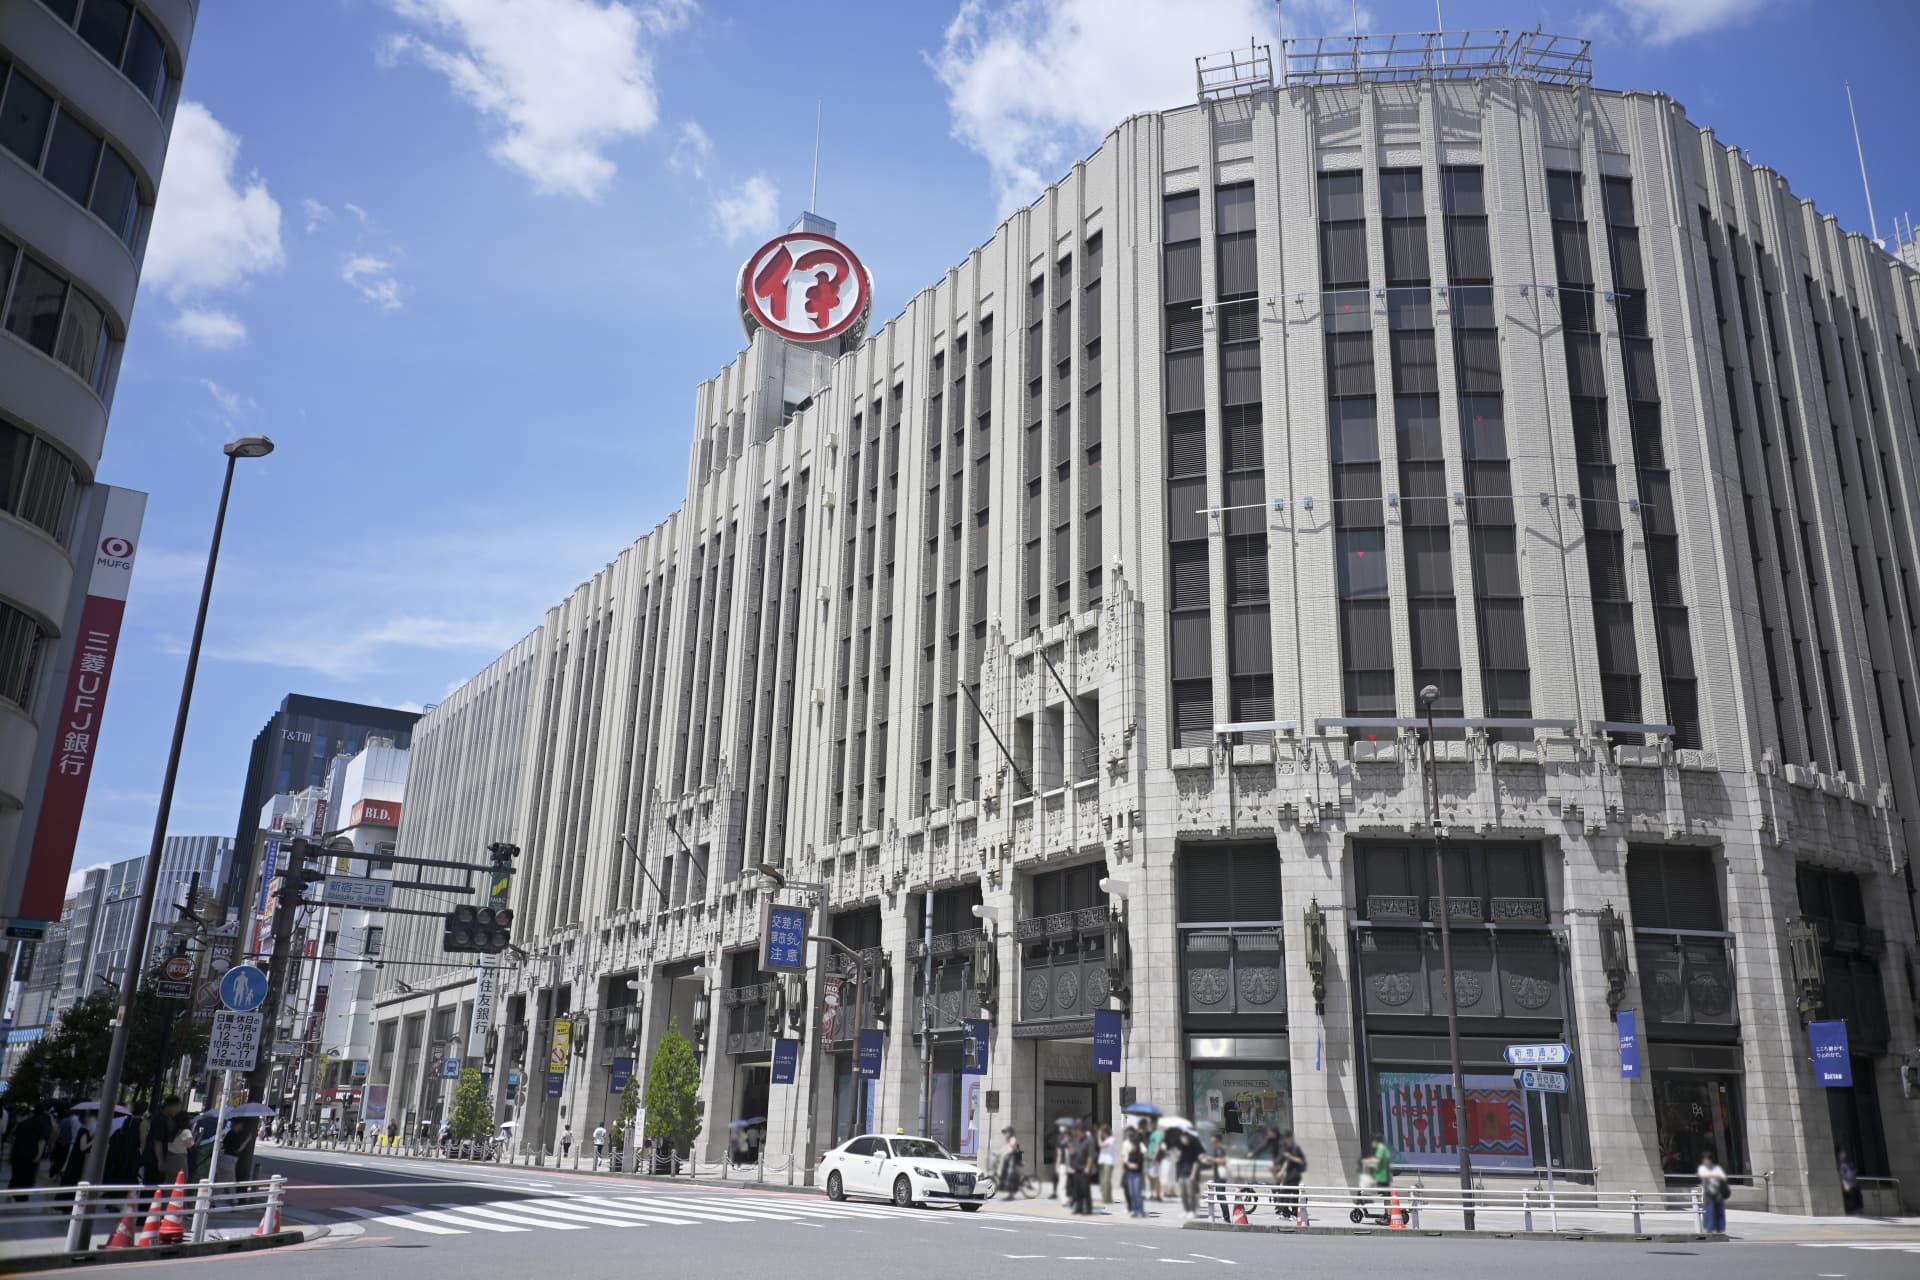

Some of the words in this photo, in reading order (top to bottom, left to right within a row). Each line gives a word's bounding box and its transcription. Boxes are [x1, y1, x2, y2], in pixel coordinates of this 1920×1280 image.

[97, 557, 130, 570] MUFG
[59, 631, 110, 776] 三菱UFJ銀行
[365, 807, 391, 821] BLD.
[329, 881, 386, 896] 新宿三丁目
[771, 915, 803, 931] 交差点
[770, 931, 801, 946] 事故多し
[770, 947, 799, 962] 注意
[475, 955, 497, 1035] 三井住友銀行
[1514, 1047, 1558, 1057] 新宿通り
